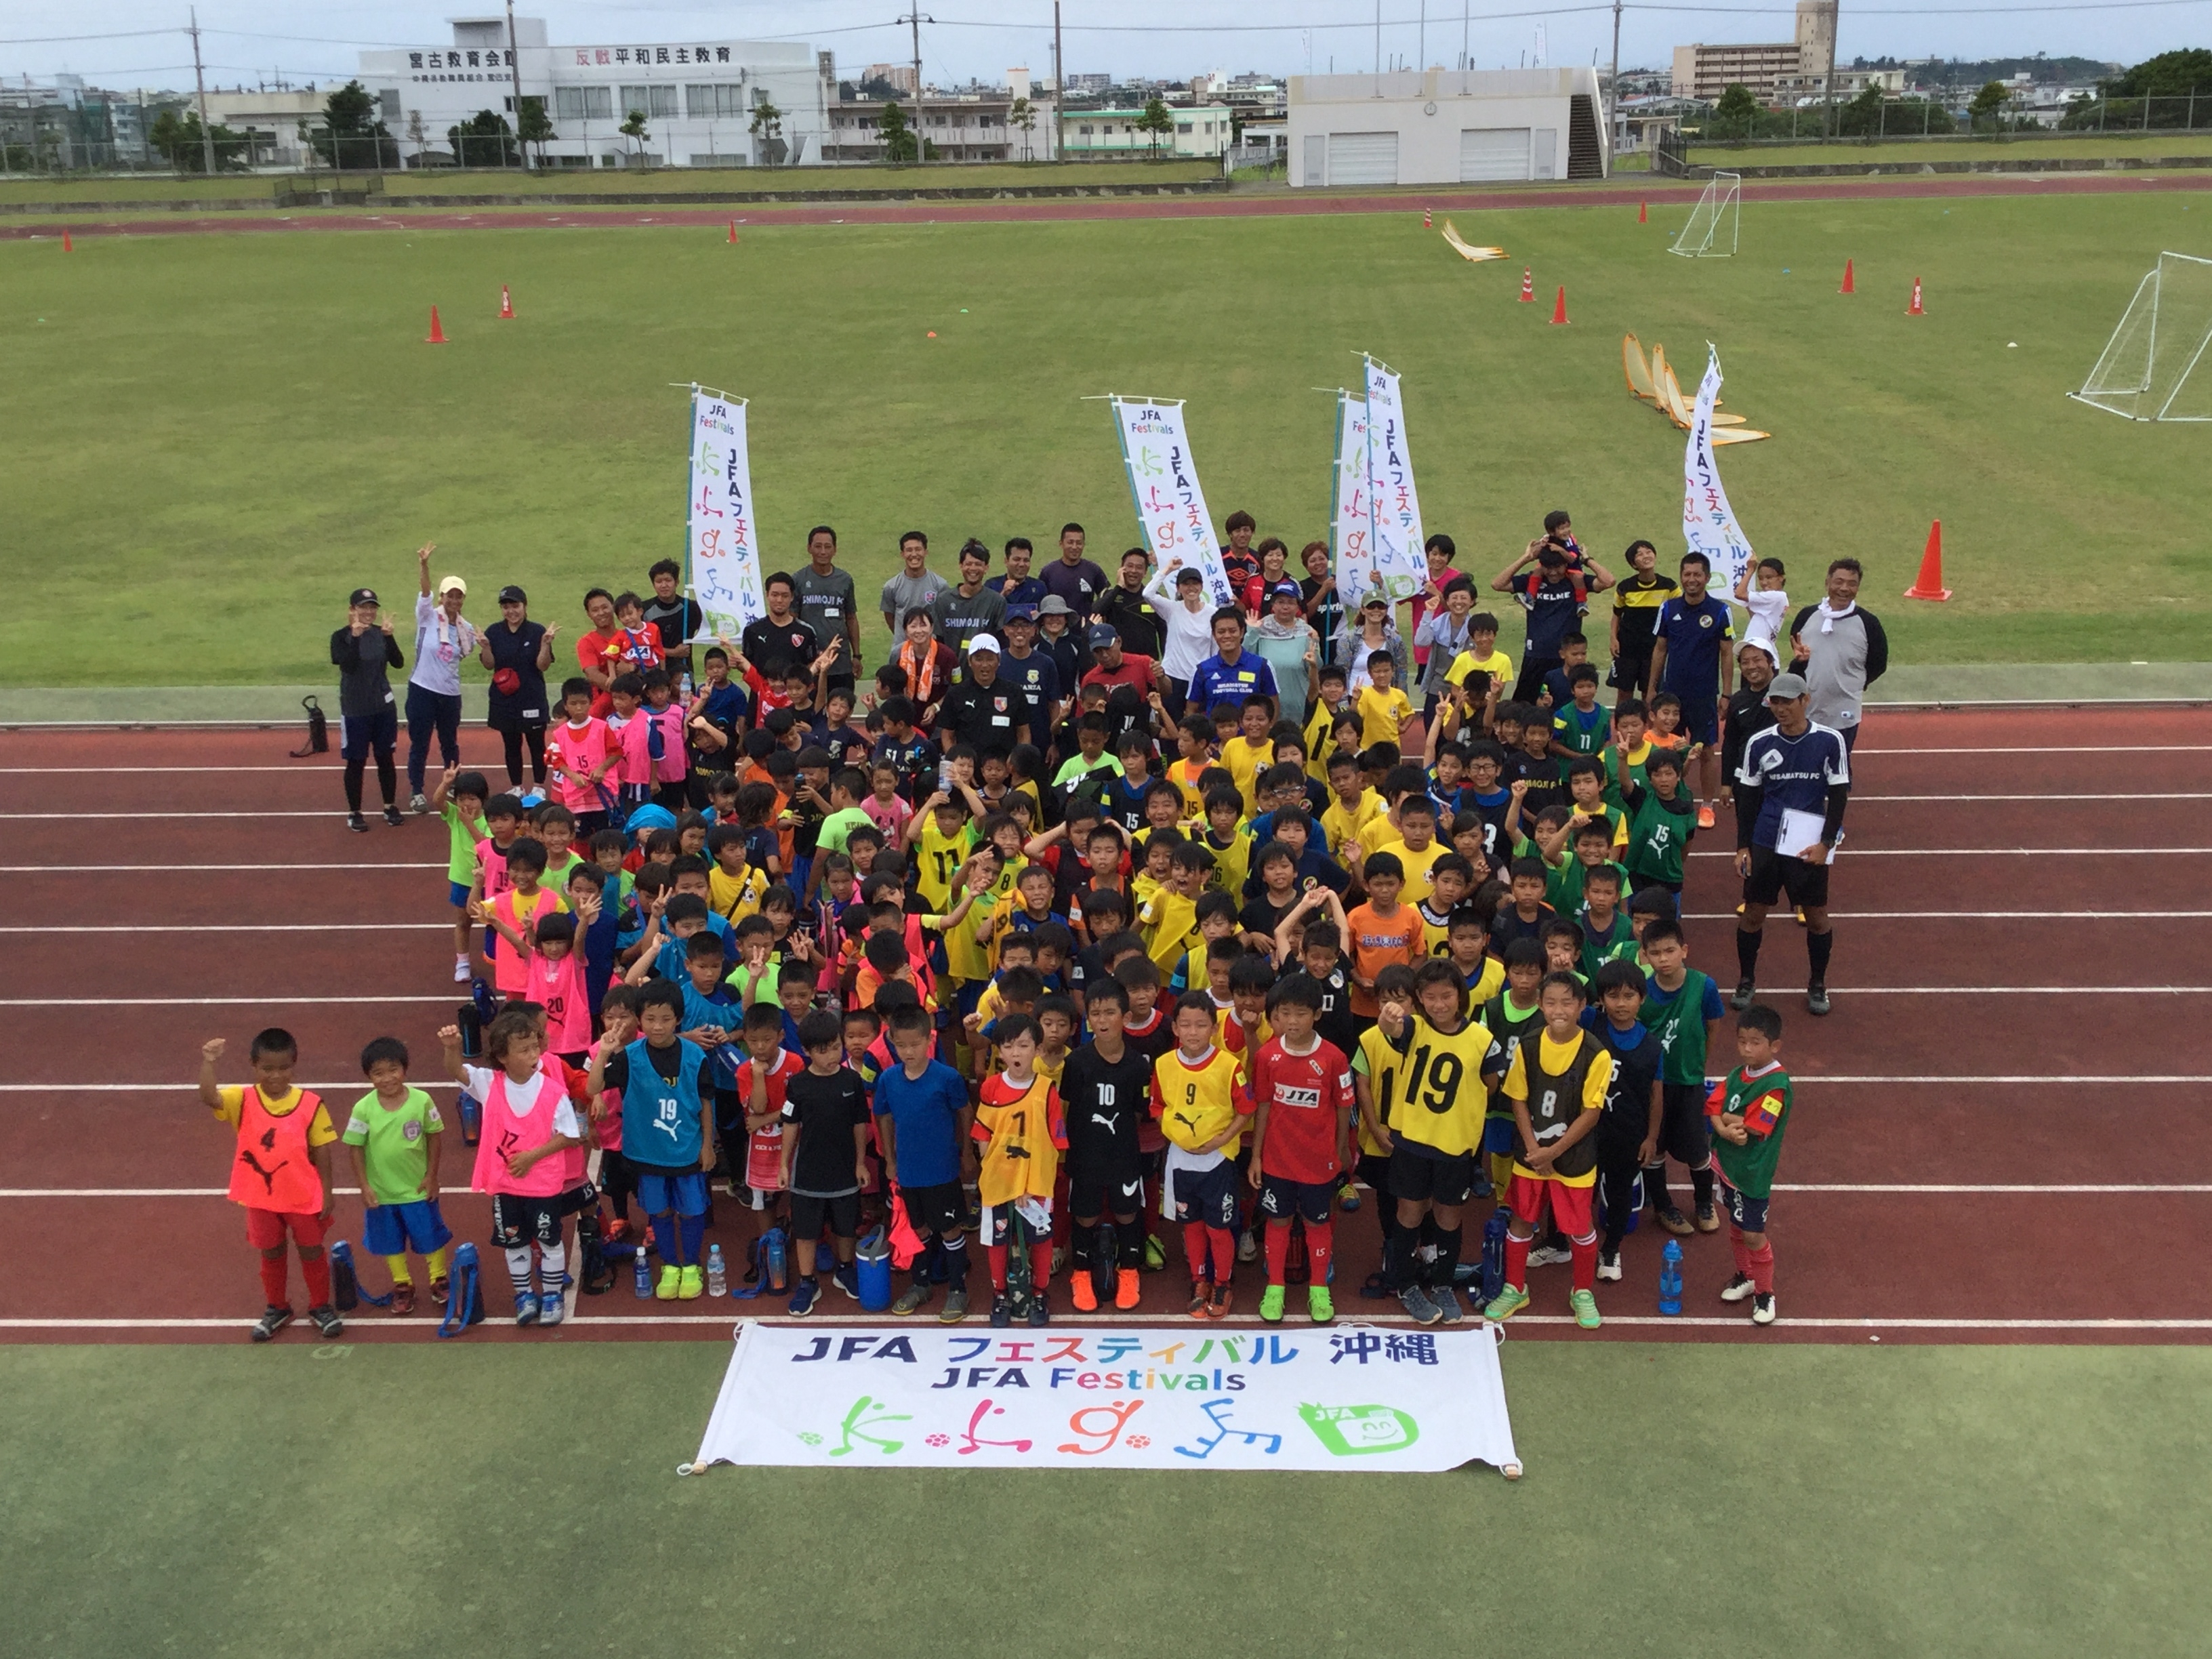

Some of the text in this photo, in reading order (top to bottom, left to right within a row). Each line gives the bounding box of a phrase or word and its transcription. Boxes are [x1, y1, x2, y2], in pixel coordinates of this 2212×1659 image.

[576, 47, 731, 66] 反戦平和民主教育
[1374, 376, 1386, 390] JFA
[710, 405, 726, 419] JFA
[1141, 410, 1161, 422] JFA
[700, 415, 734, 435] Festivals
[1132, 423, 1174, 435] Festivals
[802, 595, 835, 605] SHIMOJI
[1536, 592, 1571, 601] KELME
[945, 618, 979, 628] SHIMOJI
[1580, 734, 1591, 750] 11
[577, 755, 588, 769] 15
[1187, 800, 1198, 816] 15
[1126, 813, 1139, 830] 15
[1655, 823, 1670, 842] 15
[933, 848, 960, 884] 11
[1000, 874, 1010, 890] 8
[547, 997, 564, 1014] 20
[1405, 1044, 1463, 1114] 19
[1097, 1083, 1115, 1106] 10
[1186, 1083, 1197, 1106] 9
[1286, 1090, 1317, 1103] JTA
[658, 1099, 677, 1120] 19
[1541, 1090, 1557, 1118] 8
[1011, 1110, 1025, 1137] 1
[260, 1127, 276, 1152] 4
[501, 1129, 519, 1149] 17
[792, 1332, 1439, 1366] JFA フェスティバル 沖縄
[930, 1367, 1246, 1391] JFA Festivals
[1315, 1408, 1357, 1421] JFA
